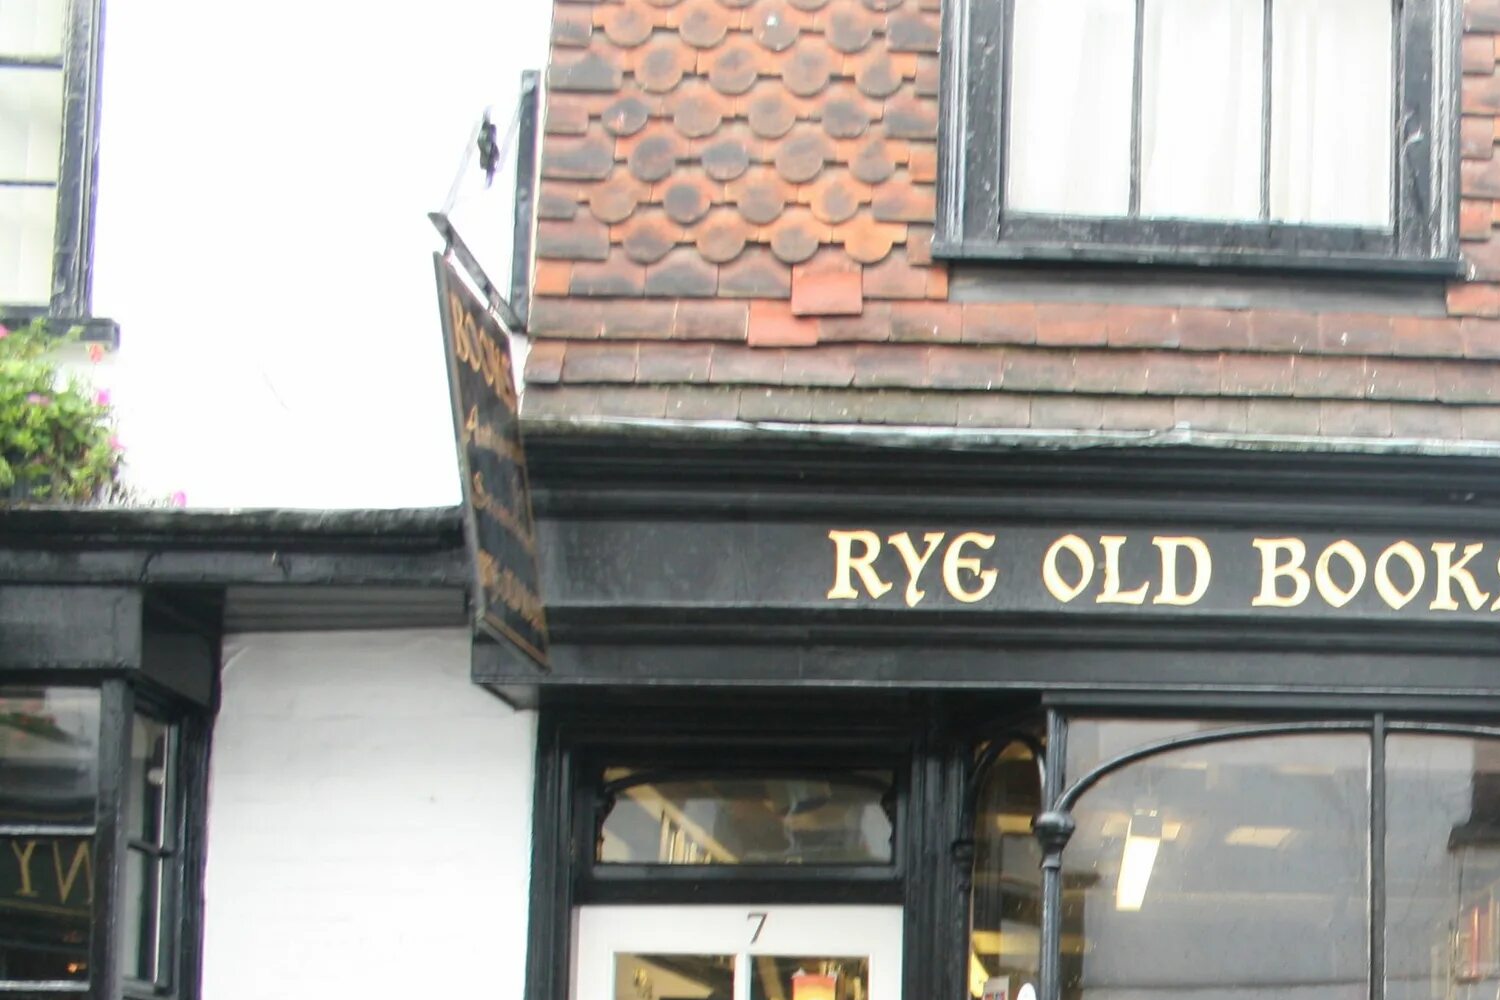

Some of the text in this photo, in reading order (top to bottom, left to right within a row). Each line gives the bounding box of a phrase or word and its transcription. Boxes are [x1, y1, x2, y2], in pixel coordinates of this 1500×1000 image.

[827, 530, 999, 607] RYE
[1042, 533, 1212, 604] OLD
[747, 912, 768, 944] 7
